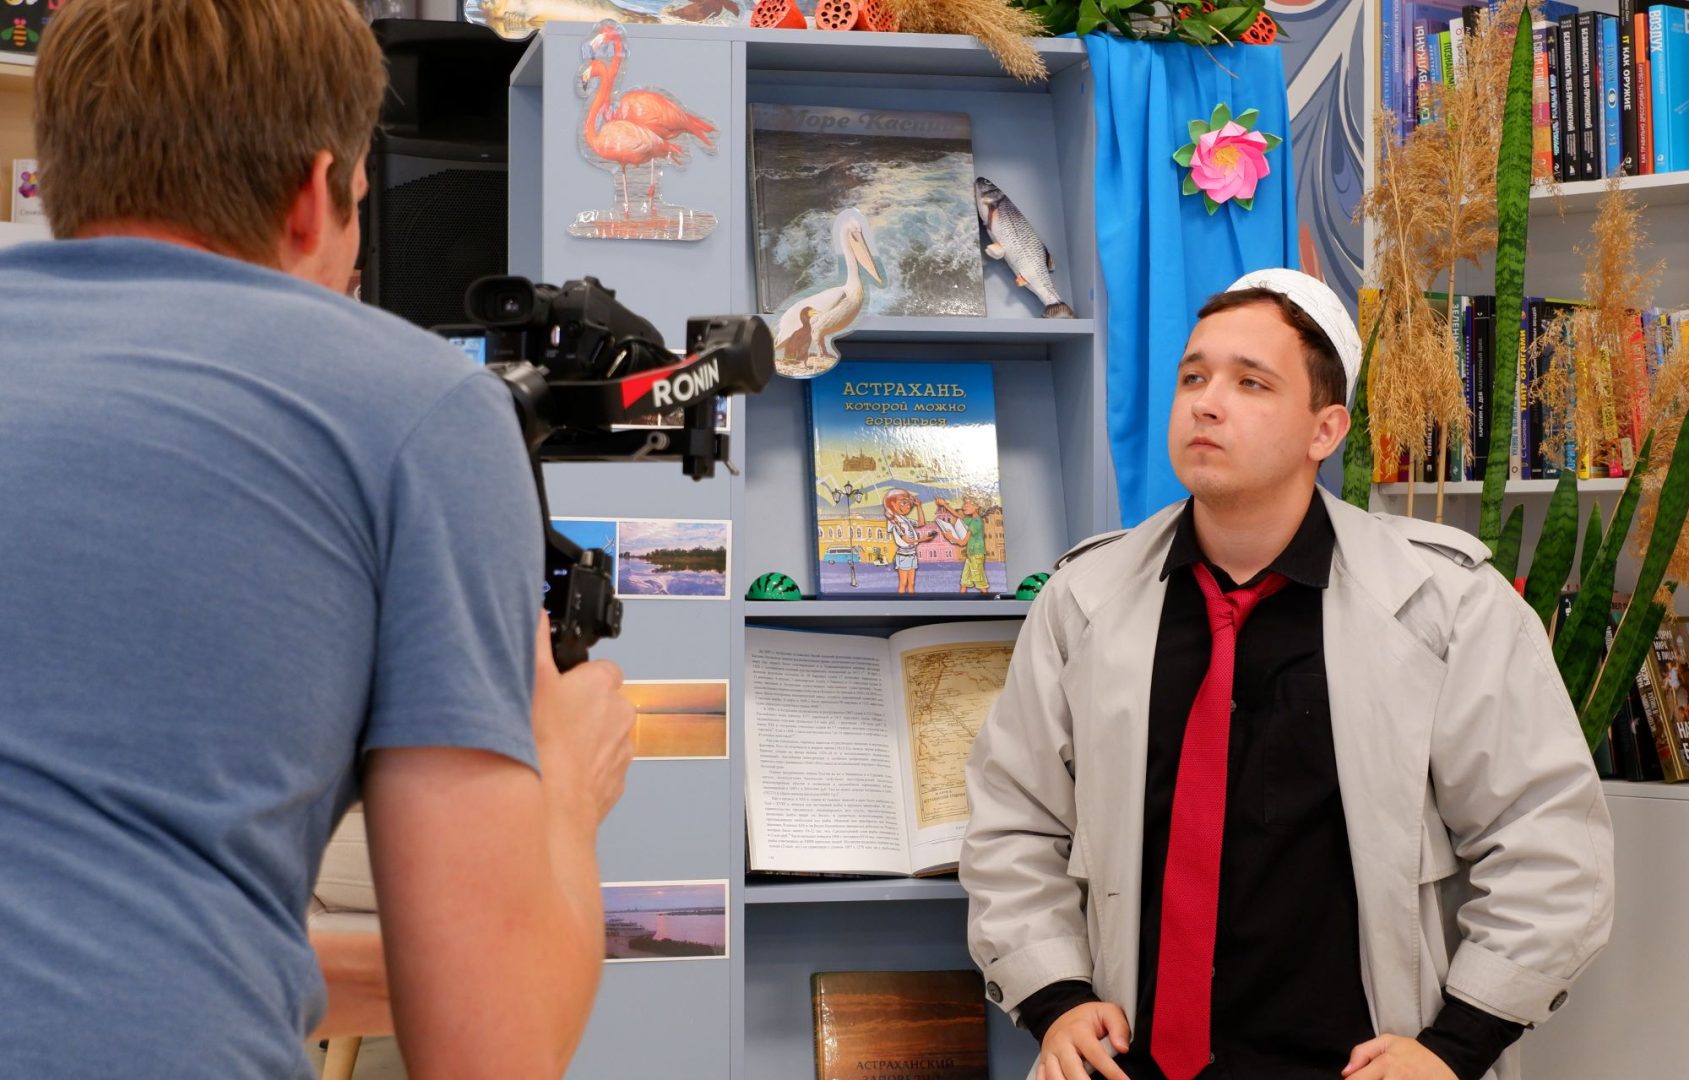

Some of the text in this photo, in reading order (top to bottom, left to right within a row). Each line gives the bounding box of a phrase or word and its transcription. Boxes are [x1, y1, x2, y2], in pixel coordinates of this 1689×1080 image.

[1622, 35, 1630, 45] IT
[1649, 10, 1663, 53] ВОЗДУХ
[1563, 31, 1573, 78] БЕЗОПАСНОСТЬ
[1581, 28, 1590, 75] БЕЗОПАСНОСТЬ
[1622, 47, 1631, 67] КАК
[1622, 69, 1632, 111] ОРУЖИЕ
[652, 358, 719, 408] RONIN
[1519, 329, 1528, 412] ТЕАТР ОРИГАМИ
[843, 382, 967, 398] АСТРАХАНЬ,
[844, 401, 966, 413] которой можно
[864, 416, 947, 427] гордиться
[856, 1058, 955, 1071] АСТРАХАНСКИЙ
